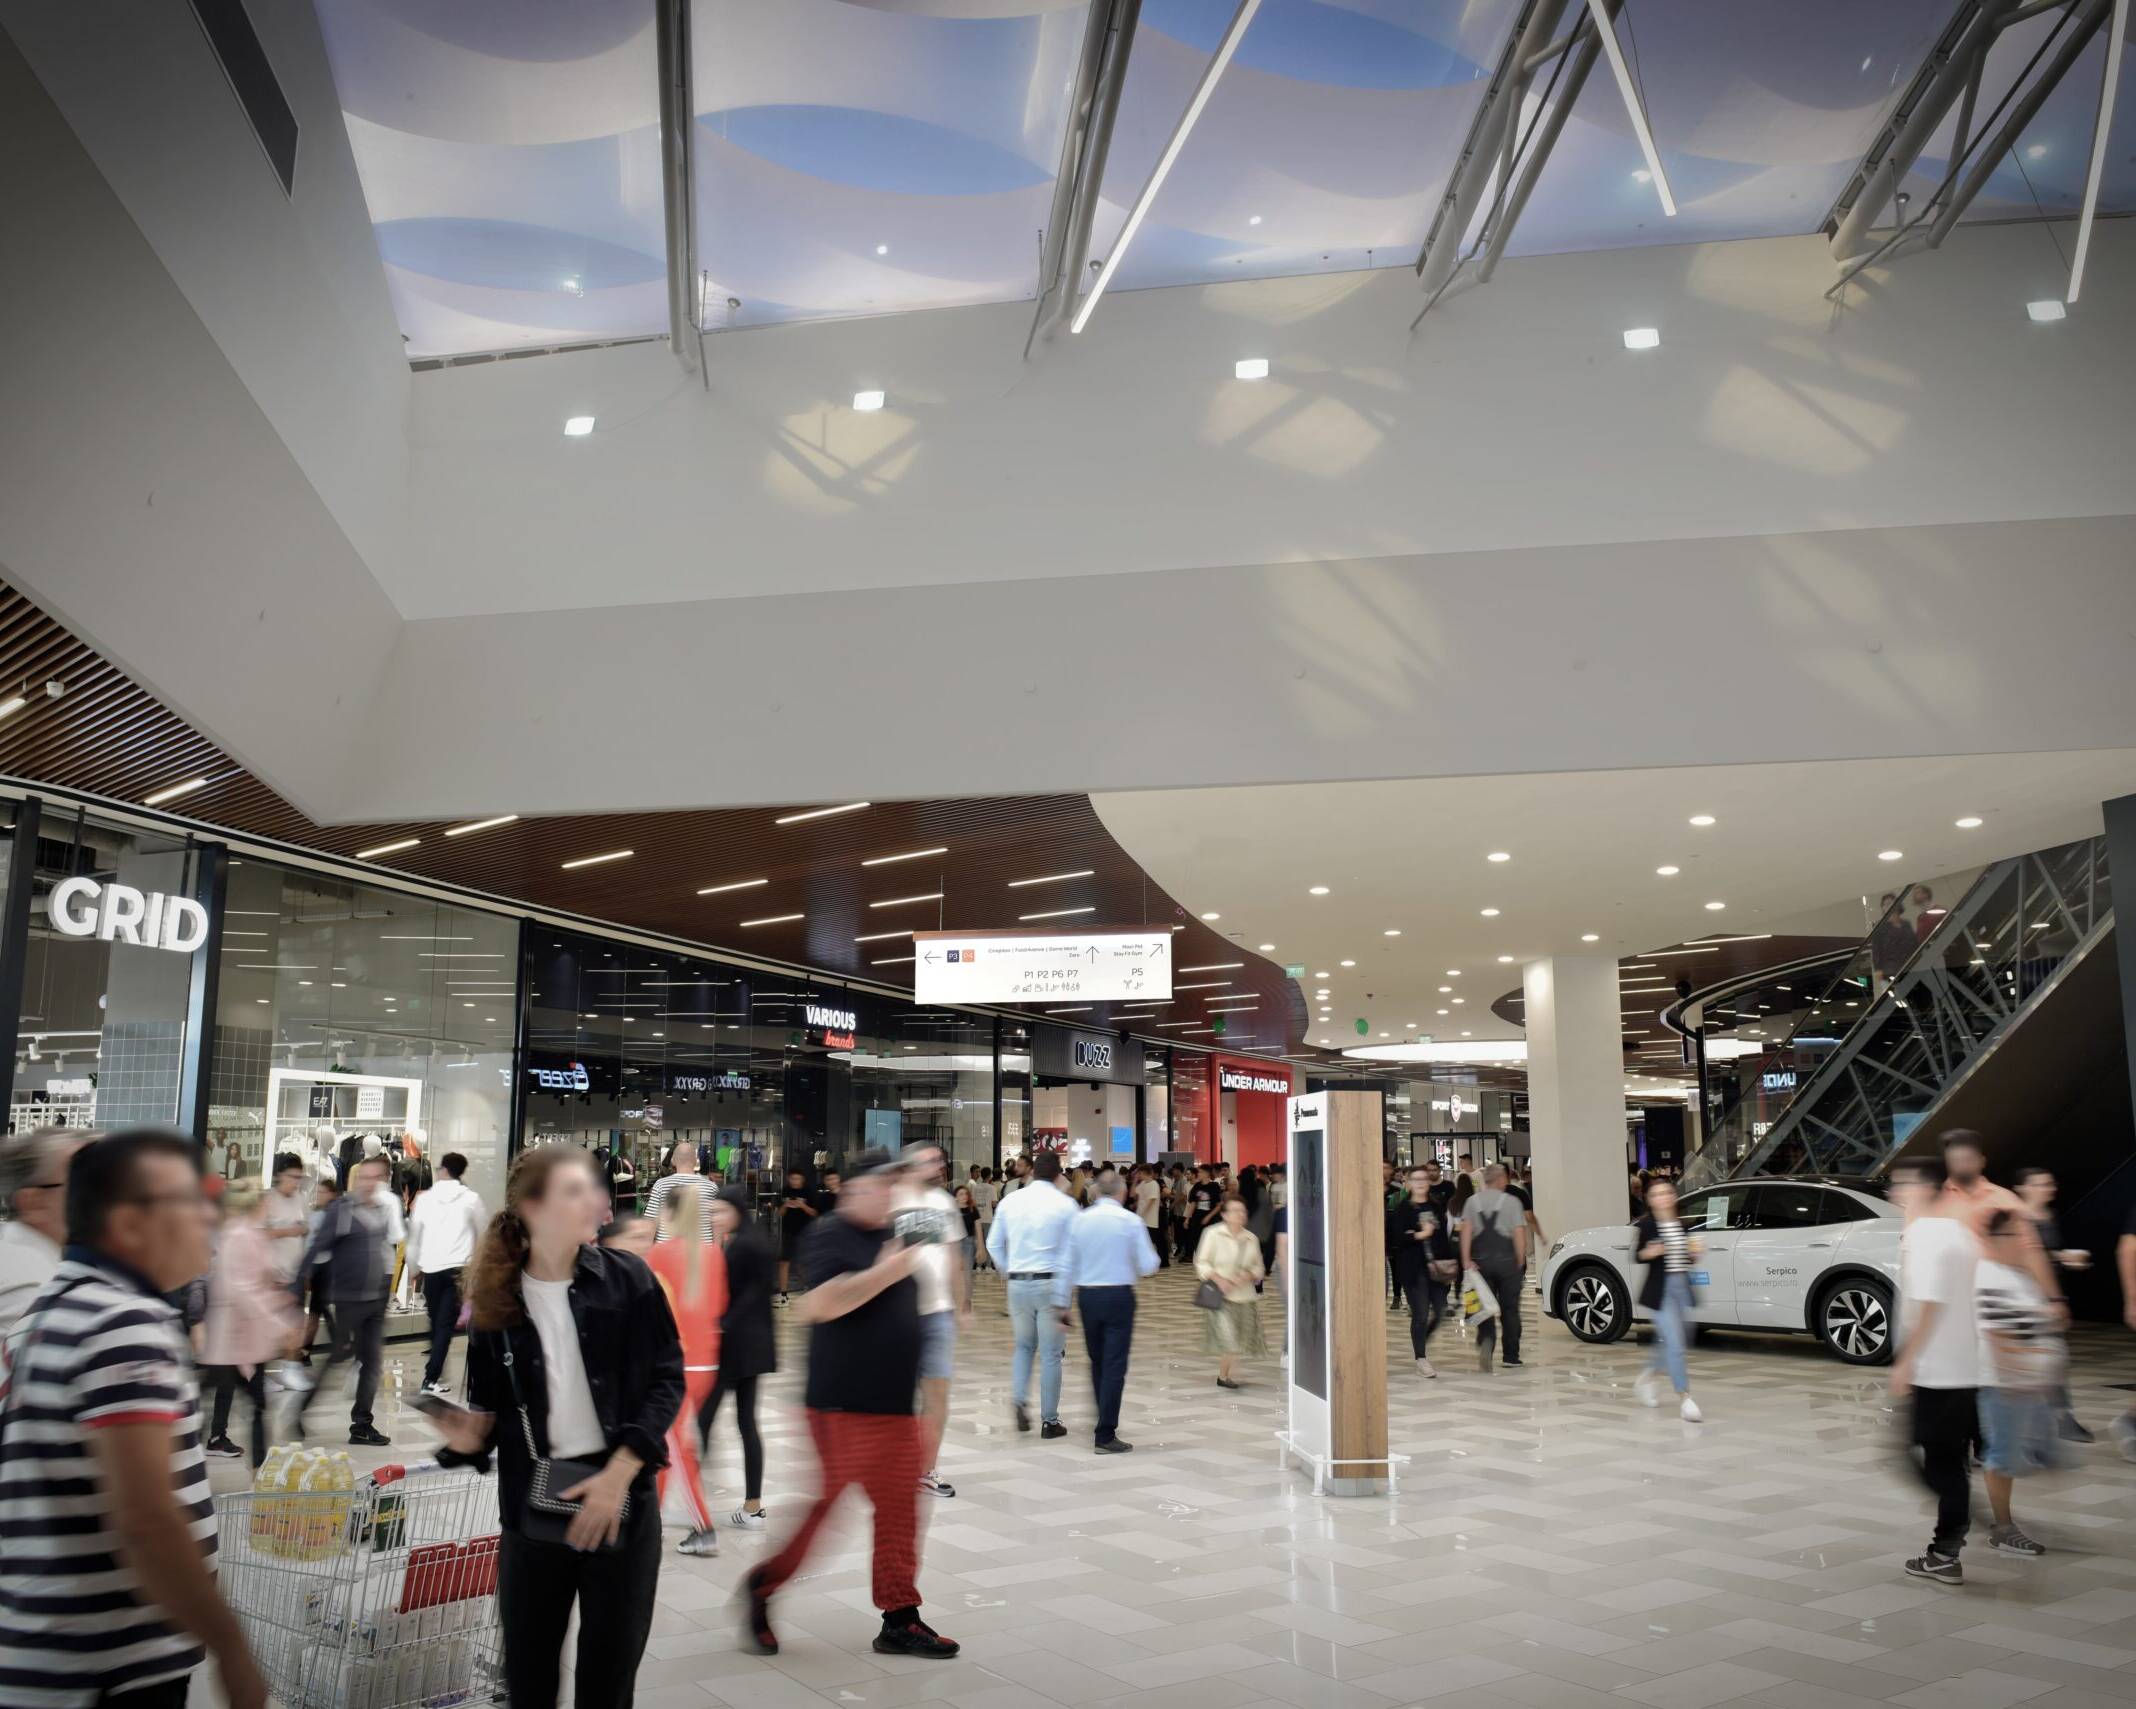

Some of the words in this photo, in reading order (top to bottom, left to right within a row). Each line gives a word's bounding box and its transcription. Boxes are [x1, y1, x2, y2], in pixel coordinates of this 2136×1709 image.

[48, 876, 209, 953] GRID
[1024, 970, 1034, 979] P1
[1037, 970, 1049, 979] P2
[1052, 969, 1064, 979] P6
[1067, 969, 1079, 978] P7
[1131, 967, 1144, 976] P5
[806, 1005, 856, 1031] VARIOUS
[825, 1029, 855, 1049] brands
[1075, 1041, 1111, 1069] BUZZ
[1222, 1073, 1252, 1090] UNDER
[1253, 1078, 1288, 1094] ARMOUR
[1766, 1266, 1798, 1276] Serpico
